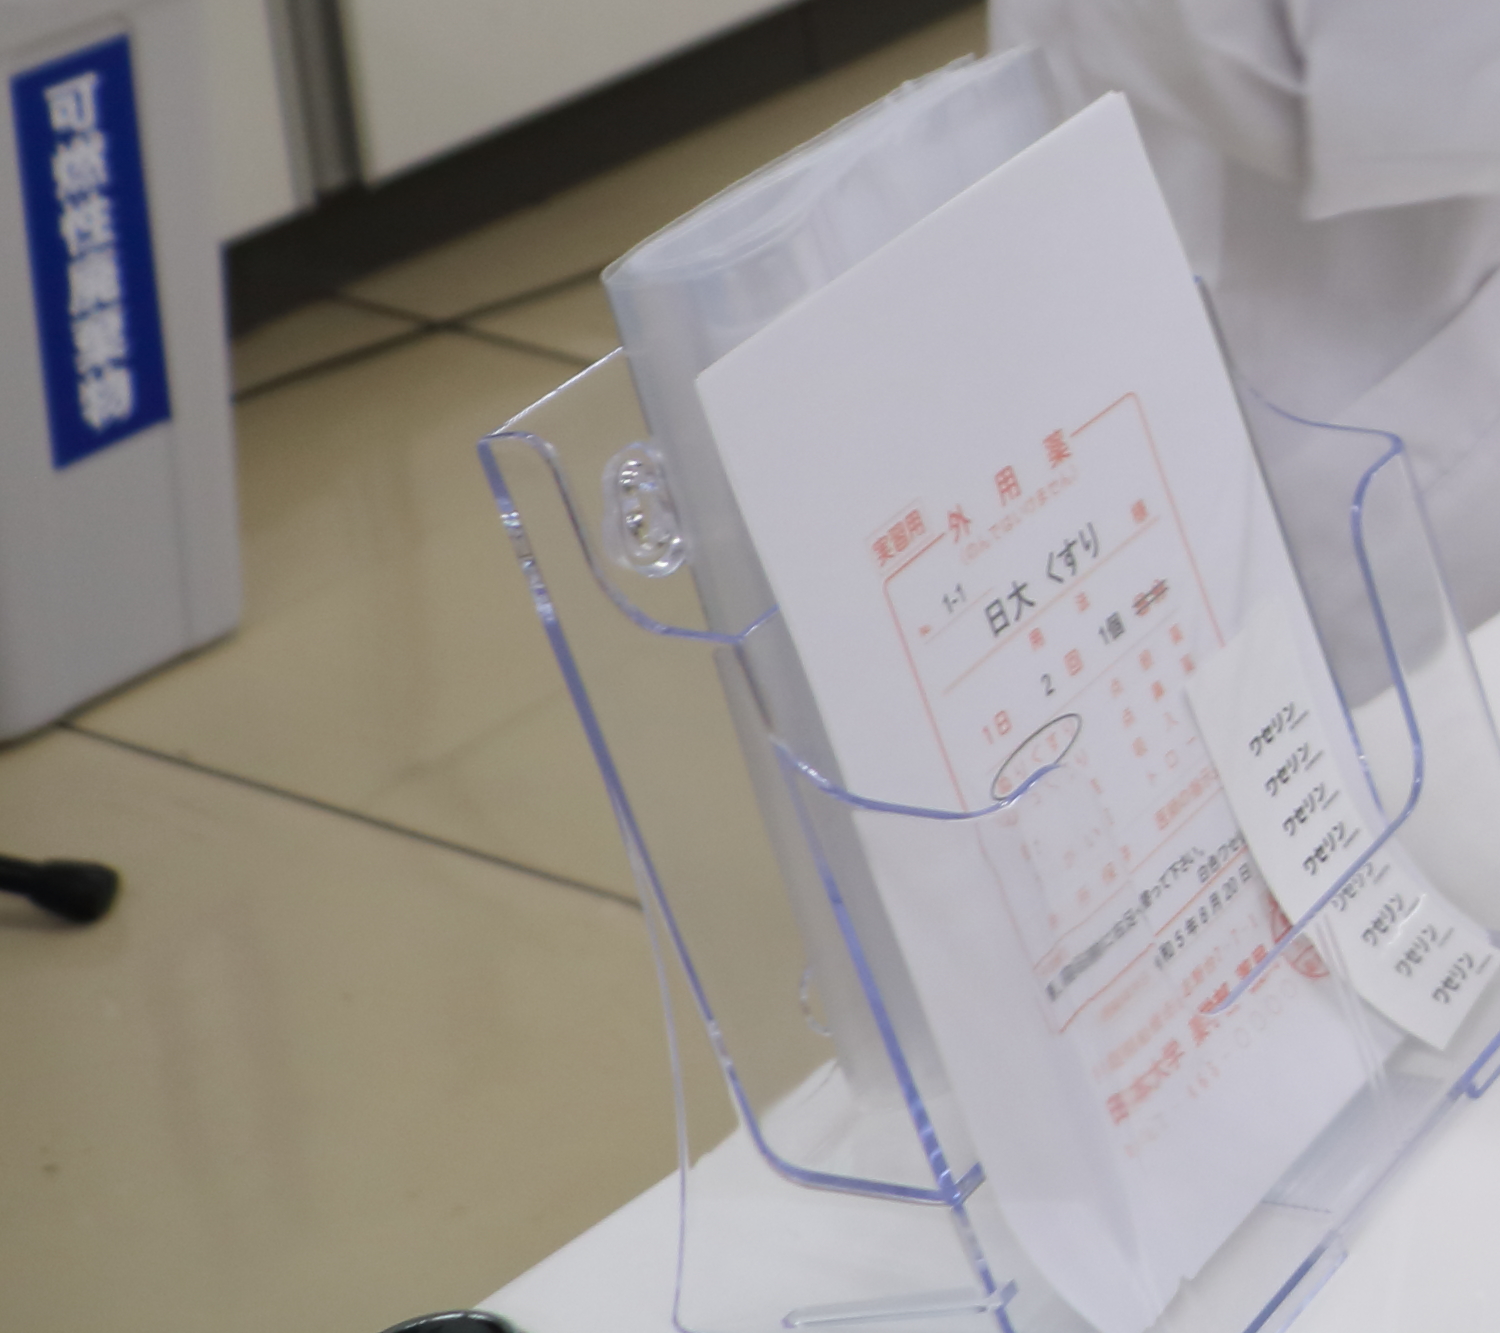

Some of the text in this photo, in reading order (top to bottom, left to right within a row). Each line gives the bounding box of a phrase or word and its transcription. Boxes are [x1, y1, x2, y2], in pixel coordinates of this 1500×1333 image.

[943, 422, 1073, 545] 外用薬
[870, 506, 927, 569] 実習用
[982, 572, 1037, 639] 日大
[1041, 519, 1102, 590] くすり
[1039, 670, 1056, 697] 2
[1249, 702, 1296, 755] ワセリン
[1264, 743, 1310, 796] ワセリン
[1282, 783, 1327, 836] ワセリン
[1302, 822, 1346, 875] ワセリン
[1361, 894, 1406, 946] ワセリン
[1394, 925, 1438, 976] ワセリン
[1432, 953, 1474, 1004] ワセリン
